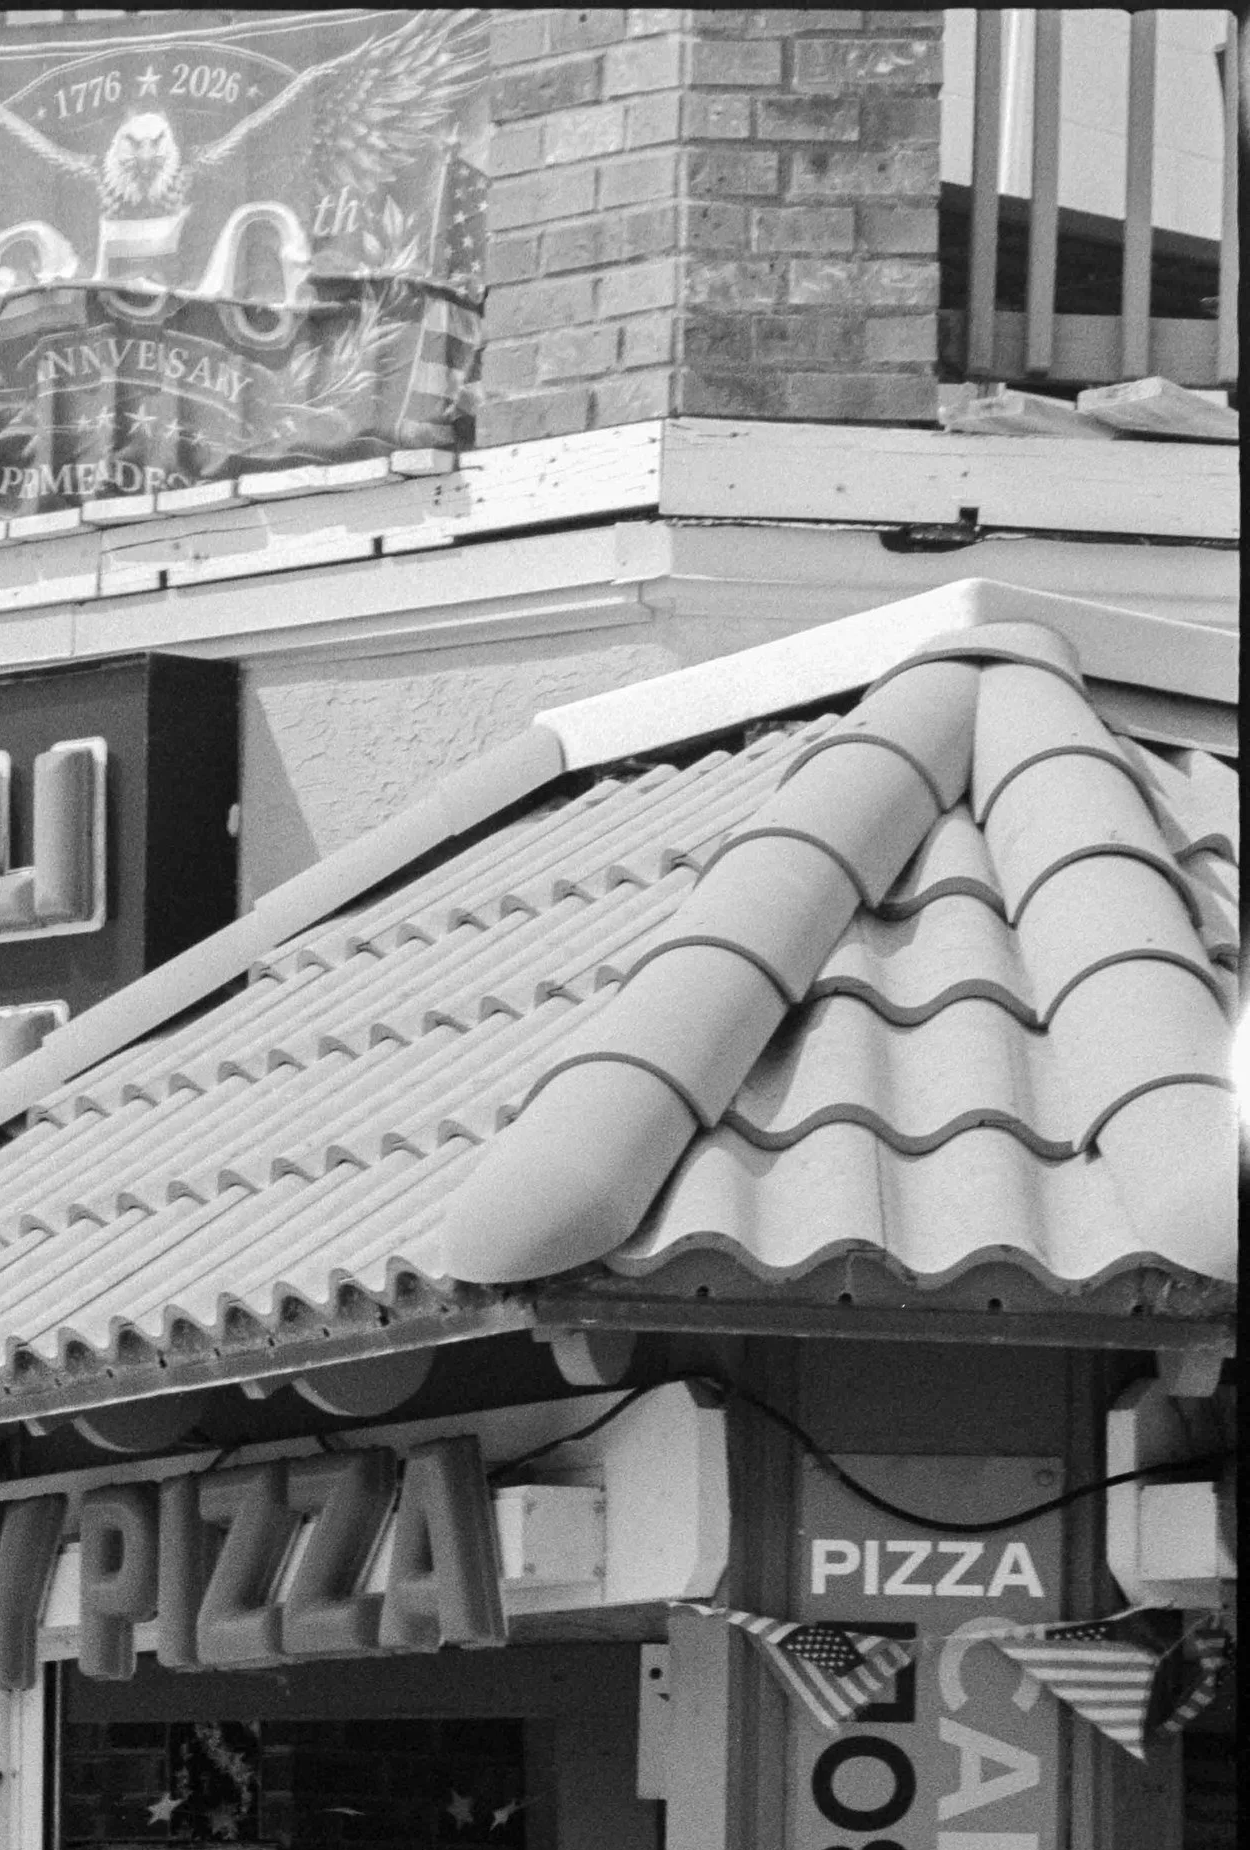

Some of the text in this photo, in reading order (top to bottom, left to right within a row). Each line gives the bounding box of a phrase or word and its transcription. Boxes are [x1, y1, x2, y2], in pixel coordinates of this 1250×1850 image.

[53, 62, 243, 119] 1776 2026
[78, 1435, 510, 1682] PIZZA
[810, 1538, 1046, 1599] PIZZA
